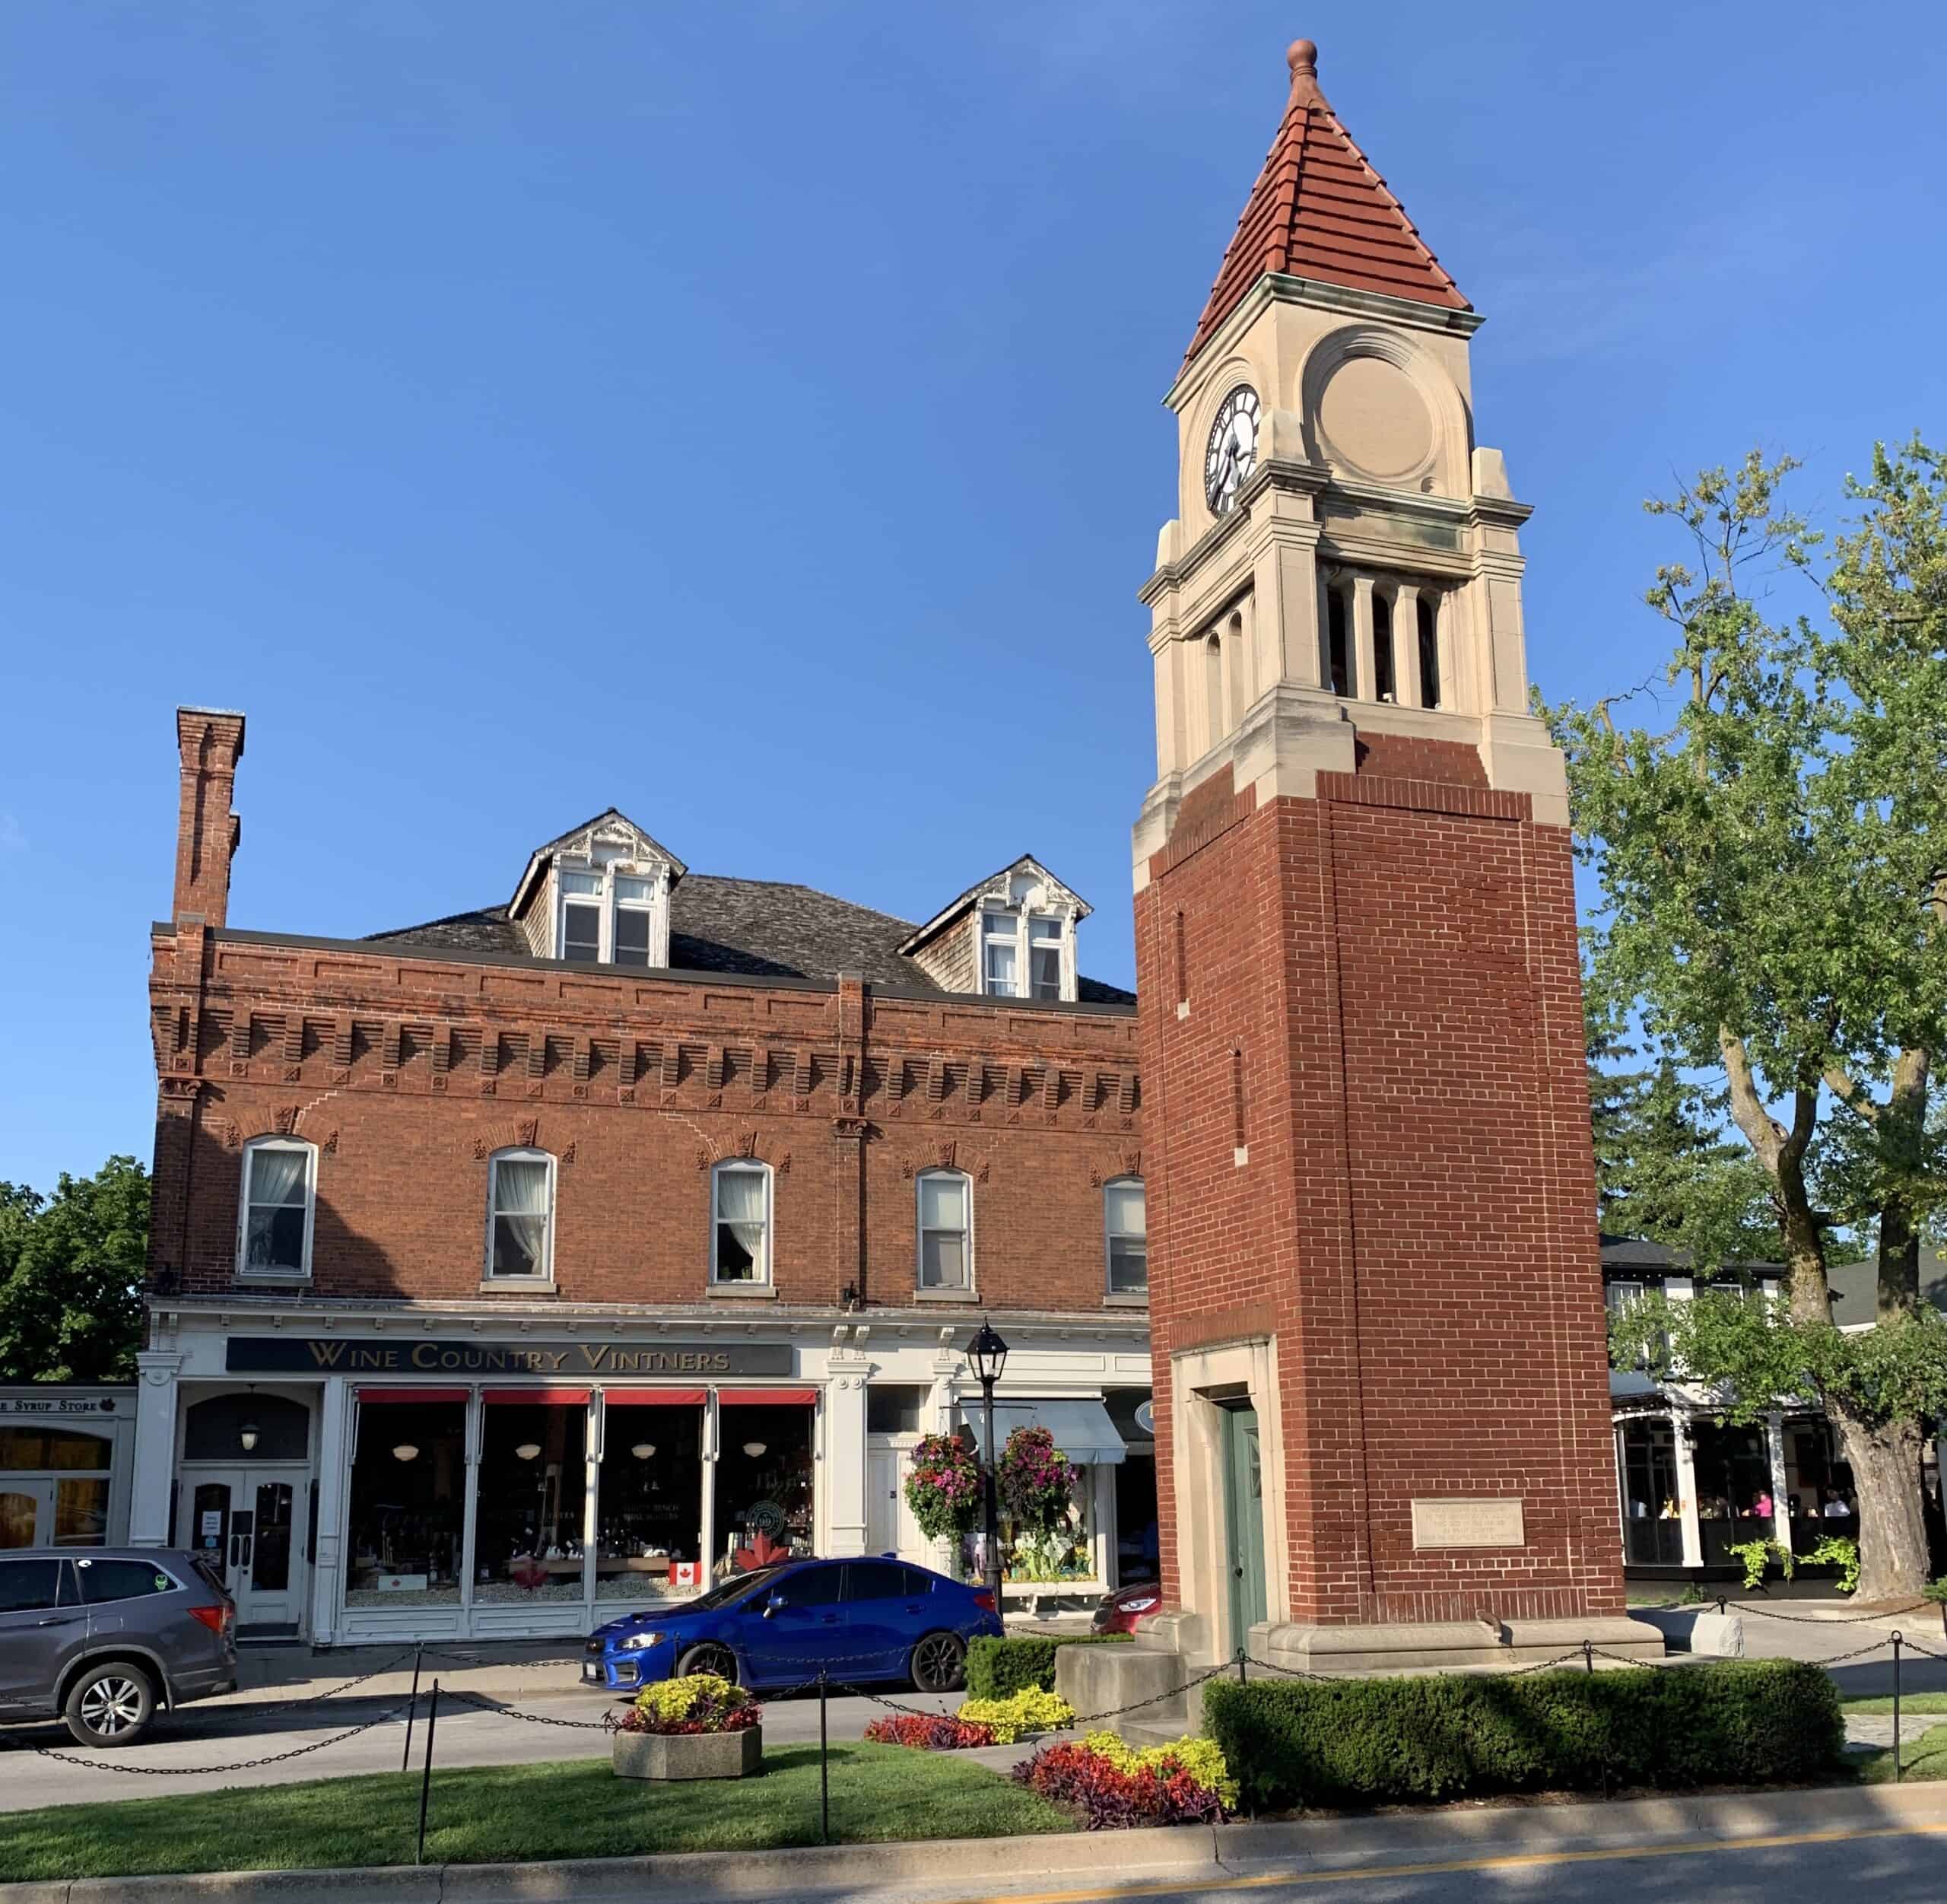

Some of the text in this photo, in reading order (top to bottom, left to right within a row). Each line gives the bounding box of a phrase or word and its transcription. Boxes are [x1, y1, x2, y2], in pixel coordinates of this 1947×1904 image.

[307, 1341, 731, 1371] WINE COUNTRY VINTNERS
[14, 1400, 52, 1410] SYRUP
[59, 1400, 97, 1411] STORE
